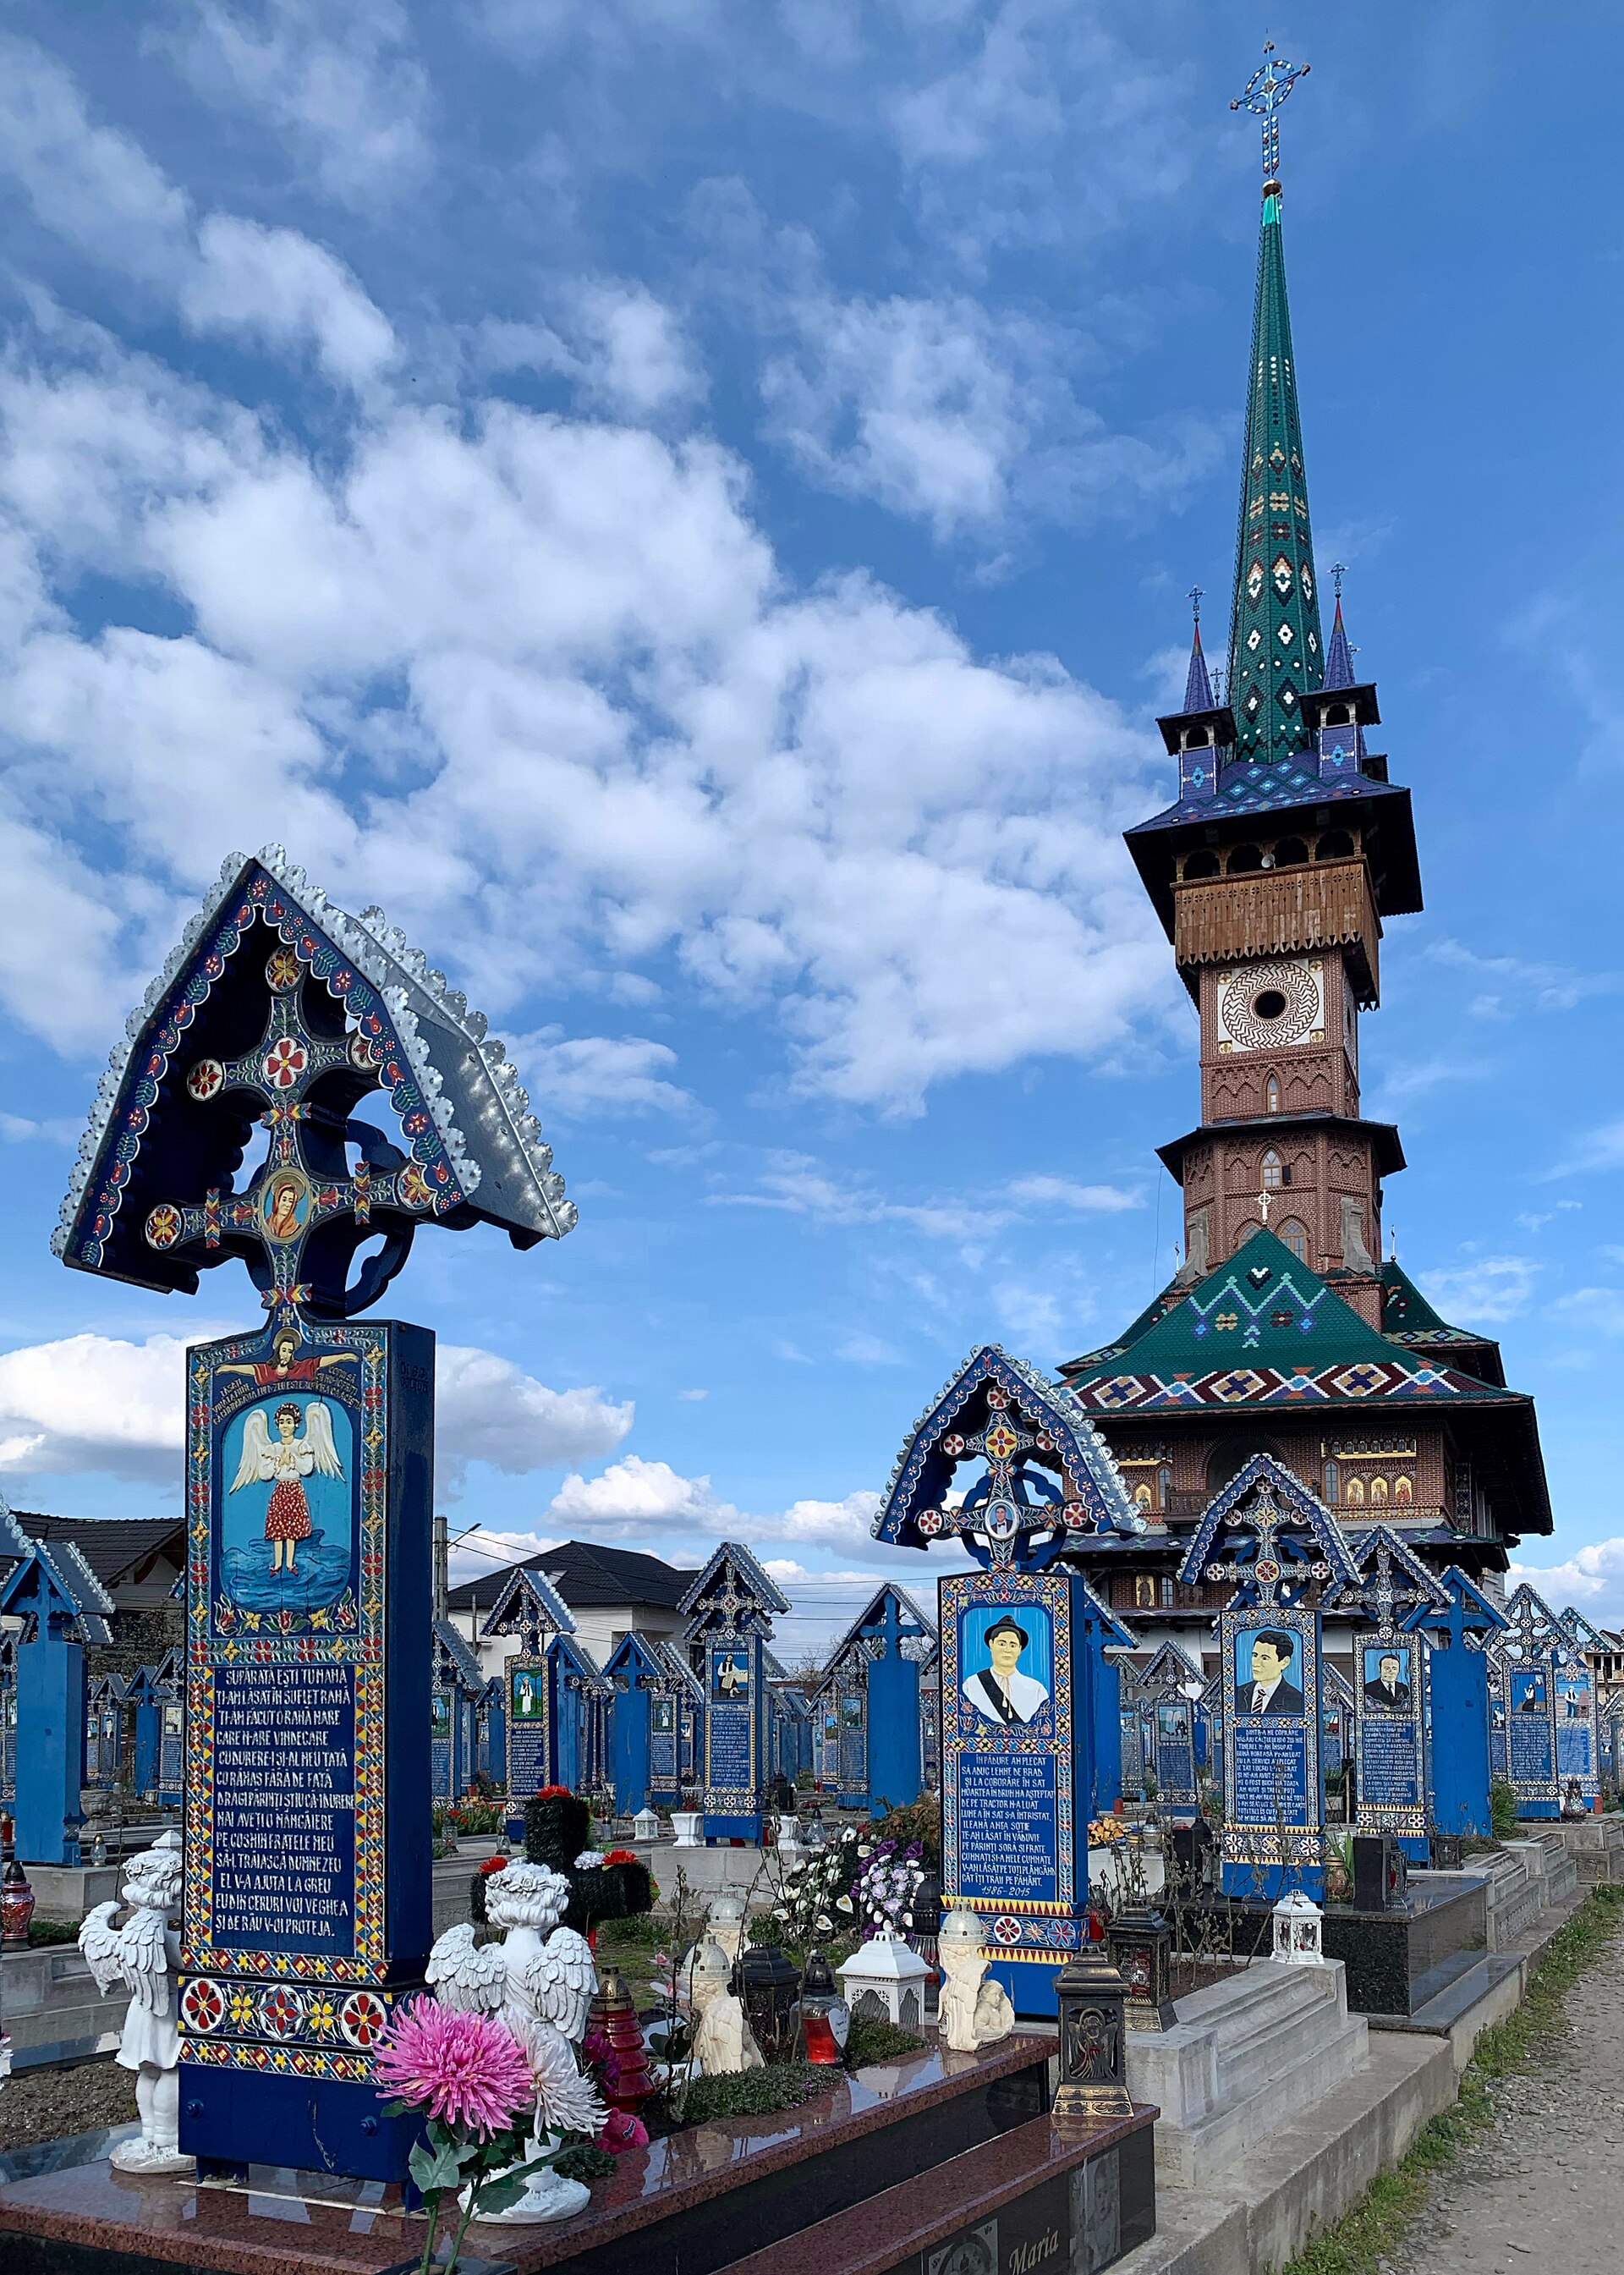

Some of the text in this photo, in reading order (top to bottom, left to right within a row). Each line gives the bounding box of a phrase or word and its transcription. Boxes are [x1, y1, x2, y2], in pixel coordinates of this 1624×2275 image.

[301, 1669, 315, 1685] TU
[283, 1690, 319, 1705] SUFLET
[277, 1710, 283, 1725] O
[313, 1710, 341, 1726] MARE
[216, 1730, 329, 1746] CARE N-ARE VINDECARE
[218, 1750, 230, 1766] CU
[300, 1751, 321, 1767] MEU
[1011, 1756, 1022, 1766] AM
[1022, 1757, 1047, 1766] PLECAT
[292, 1772, 304, 1788] DE
[972, 1767, 990, 1775] ADUC
[991, 1767, 1012, 1776] LEMNE
[1013, 1767, 1022, 1776] DE
[1023, 1767, 1043, 1777] BRAD
[974, 1778, 983, 1786] LA
[1032, 1778, 1046, 1788] SAT
[217, 1791, 247, 1806] DRAGI
[323, 1794, 355, 1810] DURERE
[961, 1788, 990, 1797] MOARTEA
[997, 1789, 1014, 1798] DRUM
[961, 1798, 1040, 1810] DE PE TRACTOR M-A LUAT
[217, 1811, 234, 1827] MAI
[266, 1813, 273, 1827] O
[991, 1810, 1004, 1819] SAT
[1005, 1811, 1016, 1819] S-A
[216, 1832, 335, 1852] PE COSMIN FRATELE MEU
[962, 1842, 970, 1850] PE
[1025, 1844, 1046, 1854] FRATE
[288, 1855, 342, 1873] DUMNEZEU
[1005, 1854, 1021, 1864] MELE
[1021, 1855, 1051, 1865] CUMNATE
[999, 1865, 1007, 1873] PE
[220, 1872, 332, 1893] EL V-A AJUTA LA GREU
[1005, 1876, 1013, 1885] PE
[216, 1893, 348, 1916] EU DIN CERURI VOI VEGHEA
[228, 1915, 240, 1931] DE
[264, 1917, 284, 1934] V-OI
[285, 1919, 336, 1937] PROTEJA.
[1009, 2227, 1059, 2275] Maria
